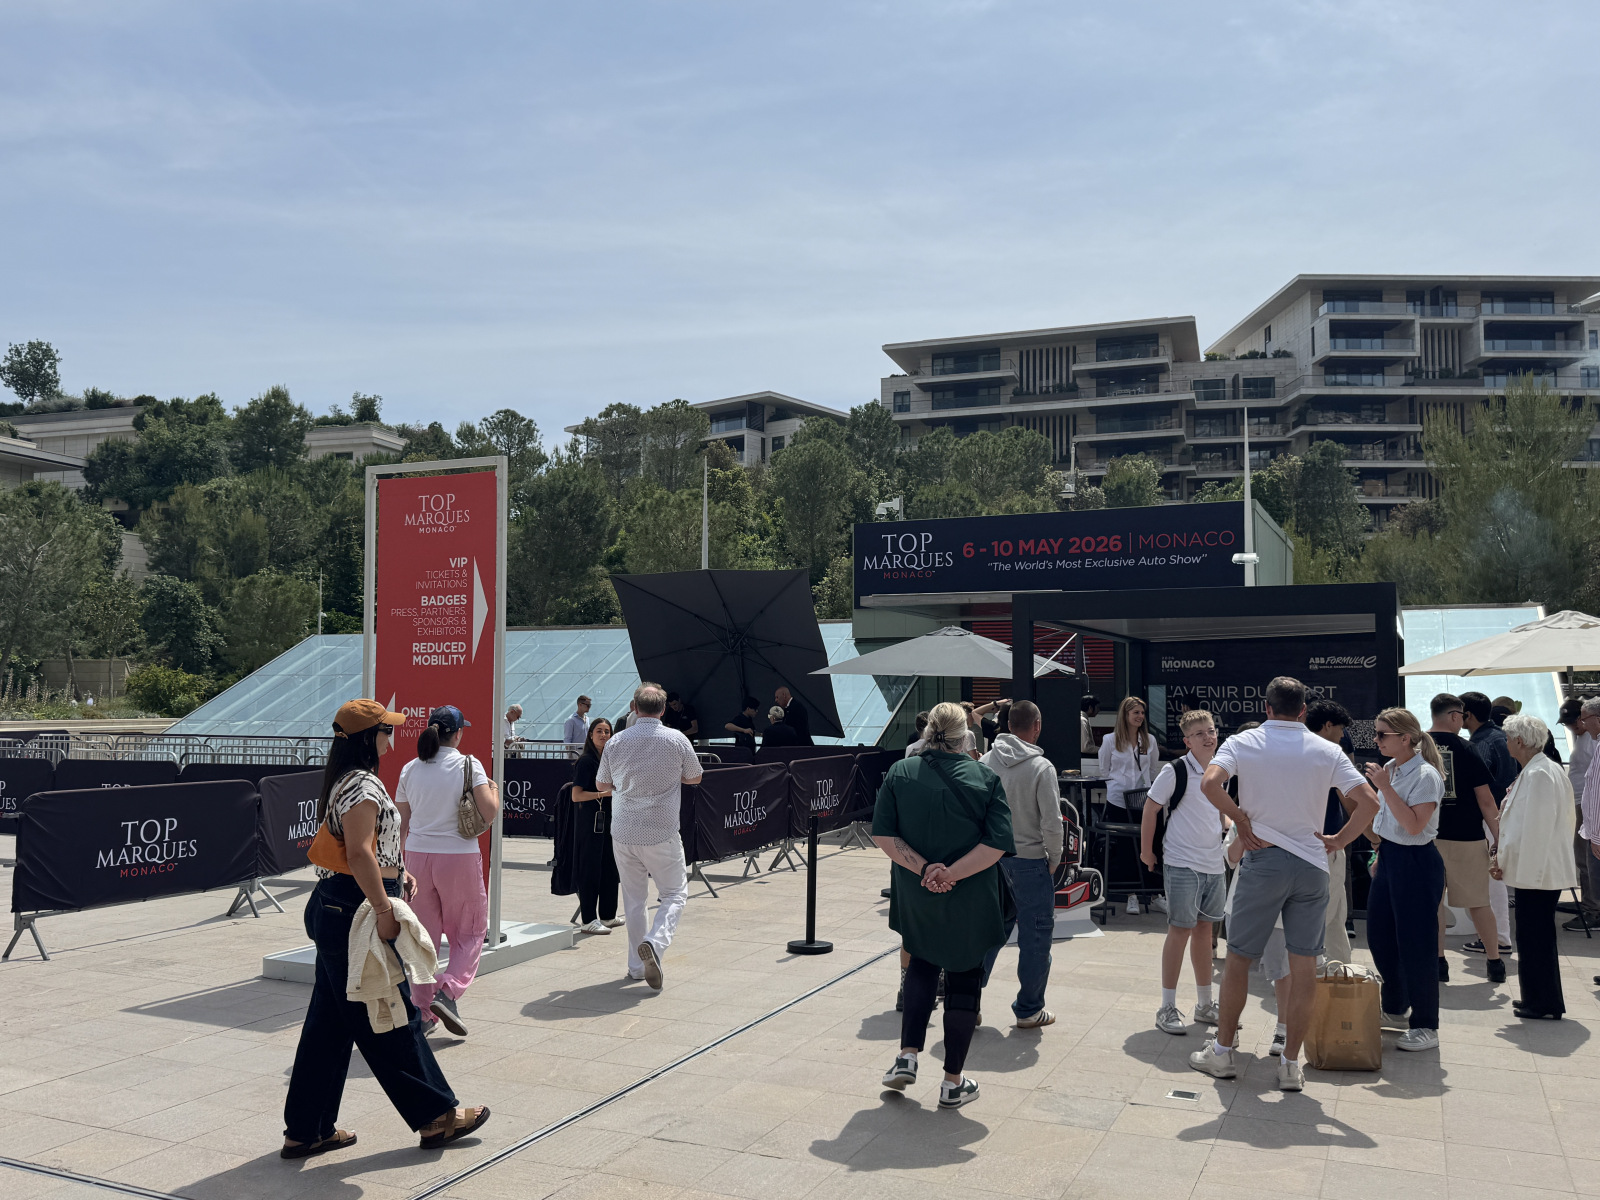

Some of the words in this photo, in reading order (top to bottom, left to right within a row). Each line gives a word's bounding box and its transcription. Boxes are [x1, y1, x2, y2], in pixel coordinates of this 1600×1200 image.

[418, 493, 456, 512] TOP
[404, 509, 470, 526] MARQUES
[419, 526, 455, 534] MONACO
[881, 532, 933, 554] TOP
[1019, 537, 1063, 556] MAY
[1068, 535, 1122, 554] 2026
[1139, 530, 1235, 550] MONACO
[449, 557, 468, 568] VIP
[863, 551, 953, 571] MARQUES
[1015, 559, 1053, 571] World's
[1056, 559, 1082, 569] Most
[1085, 557, 1135, 568] Exclusive
[1138, 555, 1166, 566] Auto
[425, 570, 460, 579] TICKETS
[461, 569, 468, 578] &
[883, 570, 934, 580] MONACO
[415, 579, 468, 590] INVITATIONS
[421, 594, 467, 606] BADGES
[391, 608, 419, 617] PRESS,
[421, 606, 467, 616] PARTNERS,
[412, 617, 459, 627] SPONSORS
[460, 616, 467, 625] &
[417, 626, 467, 636] EXHIBITORS
[412, 641, 467, 653] REDUCED
[412, 654, 467, 665] MOBILITY
[1161, 660, 1215, 669] MONACO
[1325, 655, 1364, 665] FORMULA
[401, 707, 425, 718] ONE
[1167, 700, 1266, 713] AUOMOBIL
[402, 719, 429, 728] ICKET
[816, 779, 833, 797] TOP
[733, 790, 757, 811] TOP
[810, 794, 840, 811] MARQUES
[724, 806, 767, 829] MARQUES
[121, 817, 178, 846] TOP
[288, 820, 320, 841] MARQU
[95, 839, 198, 869] MARQUES
[120, 862, 177, 878] MONACO
